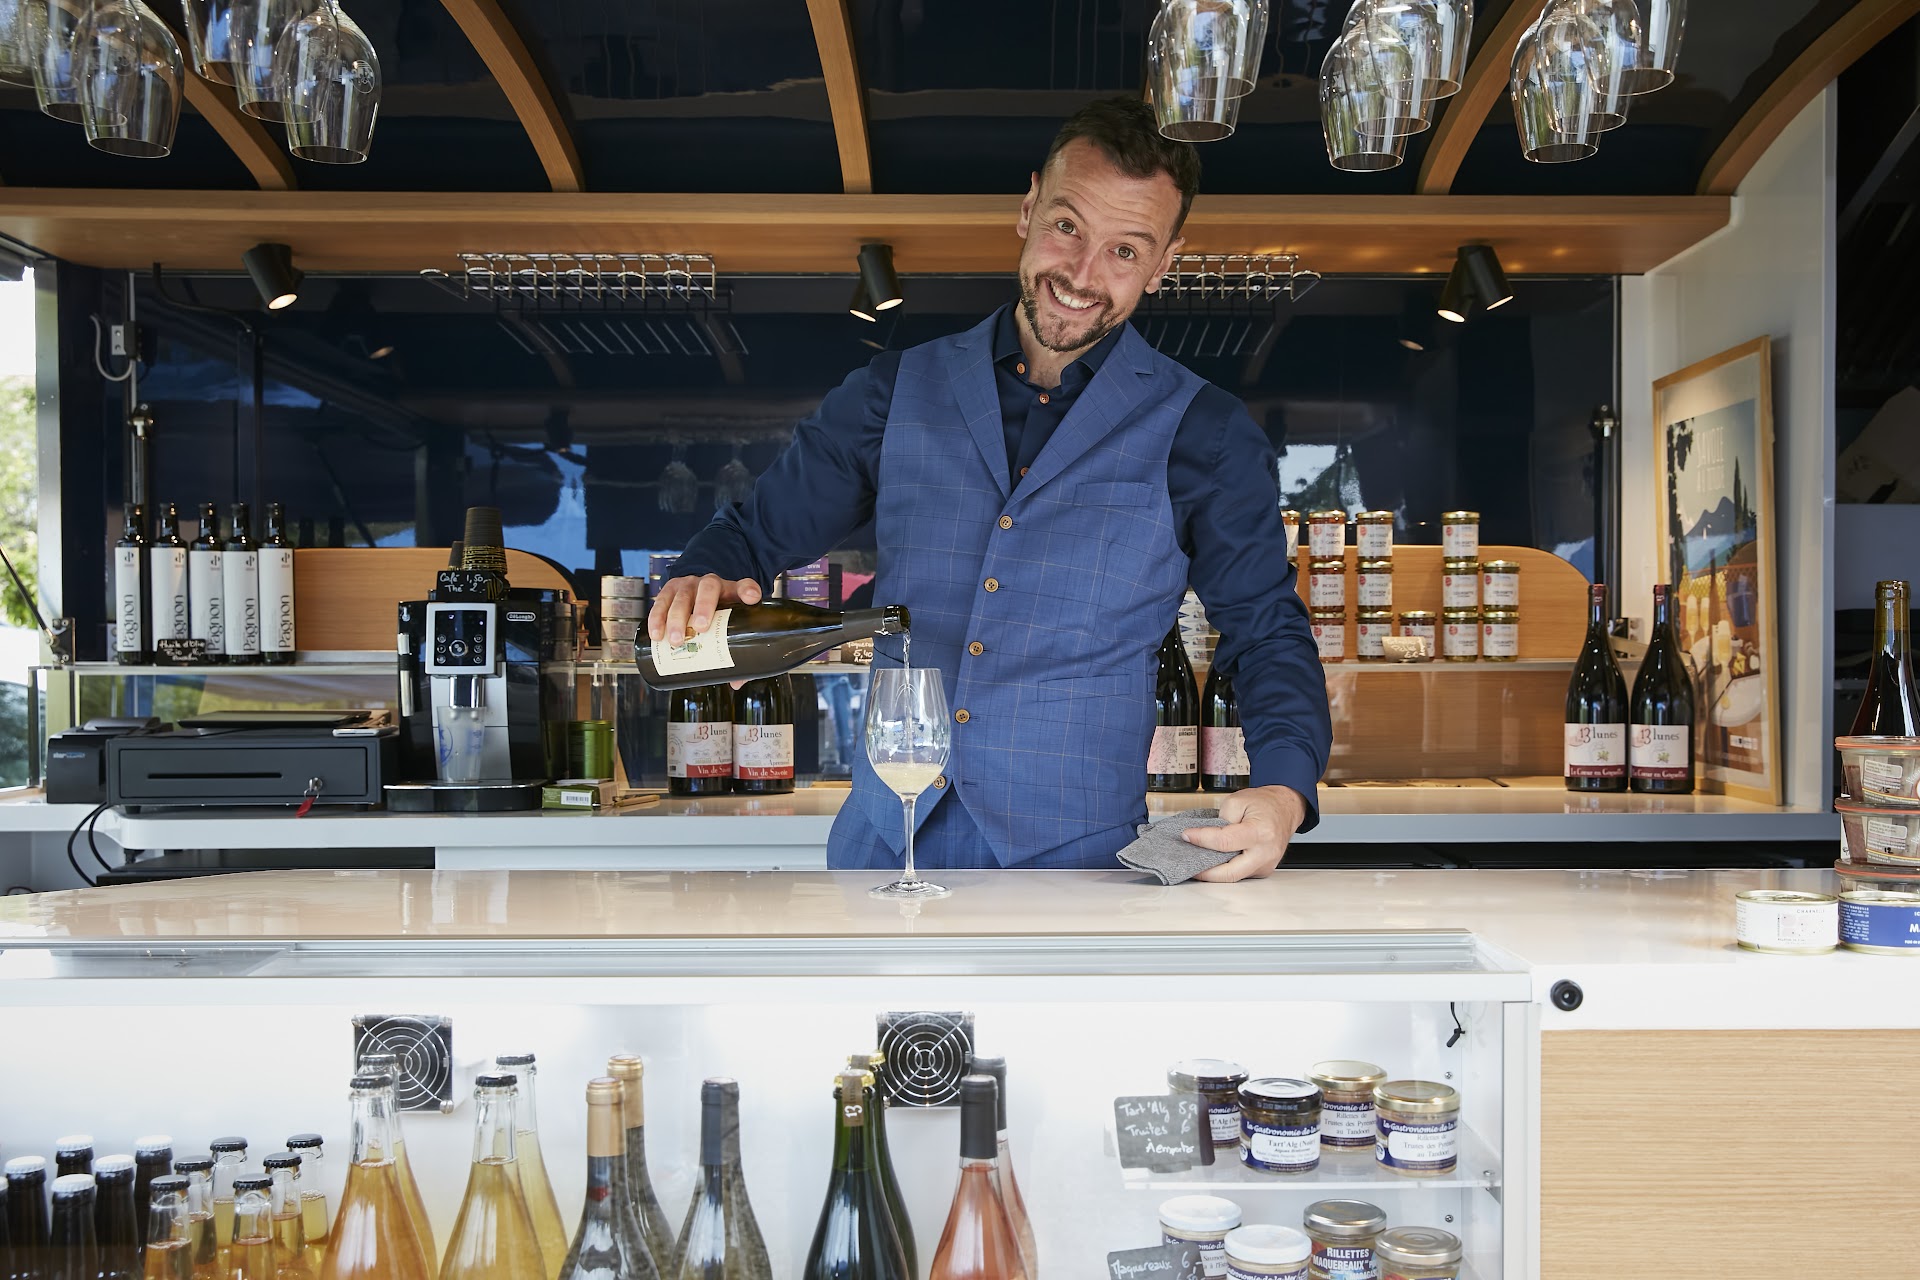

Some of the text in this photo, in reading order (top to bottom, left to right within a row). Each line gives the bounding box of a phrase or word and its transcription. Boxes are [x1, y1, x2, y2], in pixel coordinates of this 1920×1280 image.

[440, 572, 460, 584] Café
[444, 584, 463, 592] Thé
[123, 594, 138, 648] Pagnon
[174, 594, 187, 640] agnon
[279, 595, 292, 648] Pagnon
[208, 597, 221, 651] Pagnon
[243, 598, 257, 651] Pagnon
[854, 650, 873, 659] 5,40
[699, 726, 709, 740] 13
[710, 725, 728, 735] lunes
[749, 728, 758, 742] 13
[760, 727, 782, 738] lunes
[1580, 727, 1618, 743] 13 lunes
[1641, 728, 1680, 744] 13 lunes
[697, 765, 709, 774] Vin
[711, 765, 718, 774] de
[747, 767, 788, 776] Vin de Savoie
[1910, 924, 1920, 933] M
[845, 1105, 862, 1117] 13
[1322, 1102, 1358, 1111] tronomie
[1125, 1122, 1168, 1136] Truites
[1254, 1124, 1302, 1136] Gastronomie
[1391, 1123, 1438, 1133] Gastronomie
[1268, 1139, 1298, 1148] Tart'Alg
[1327, 1247, 1369, 1258] RILLETTES
